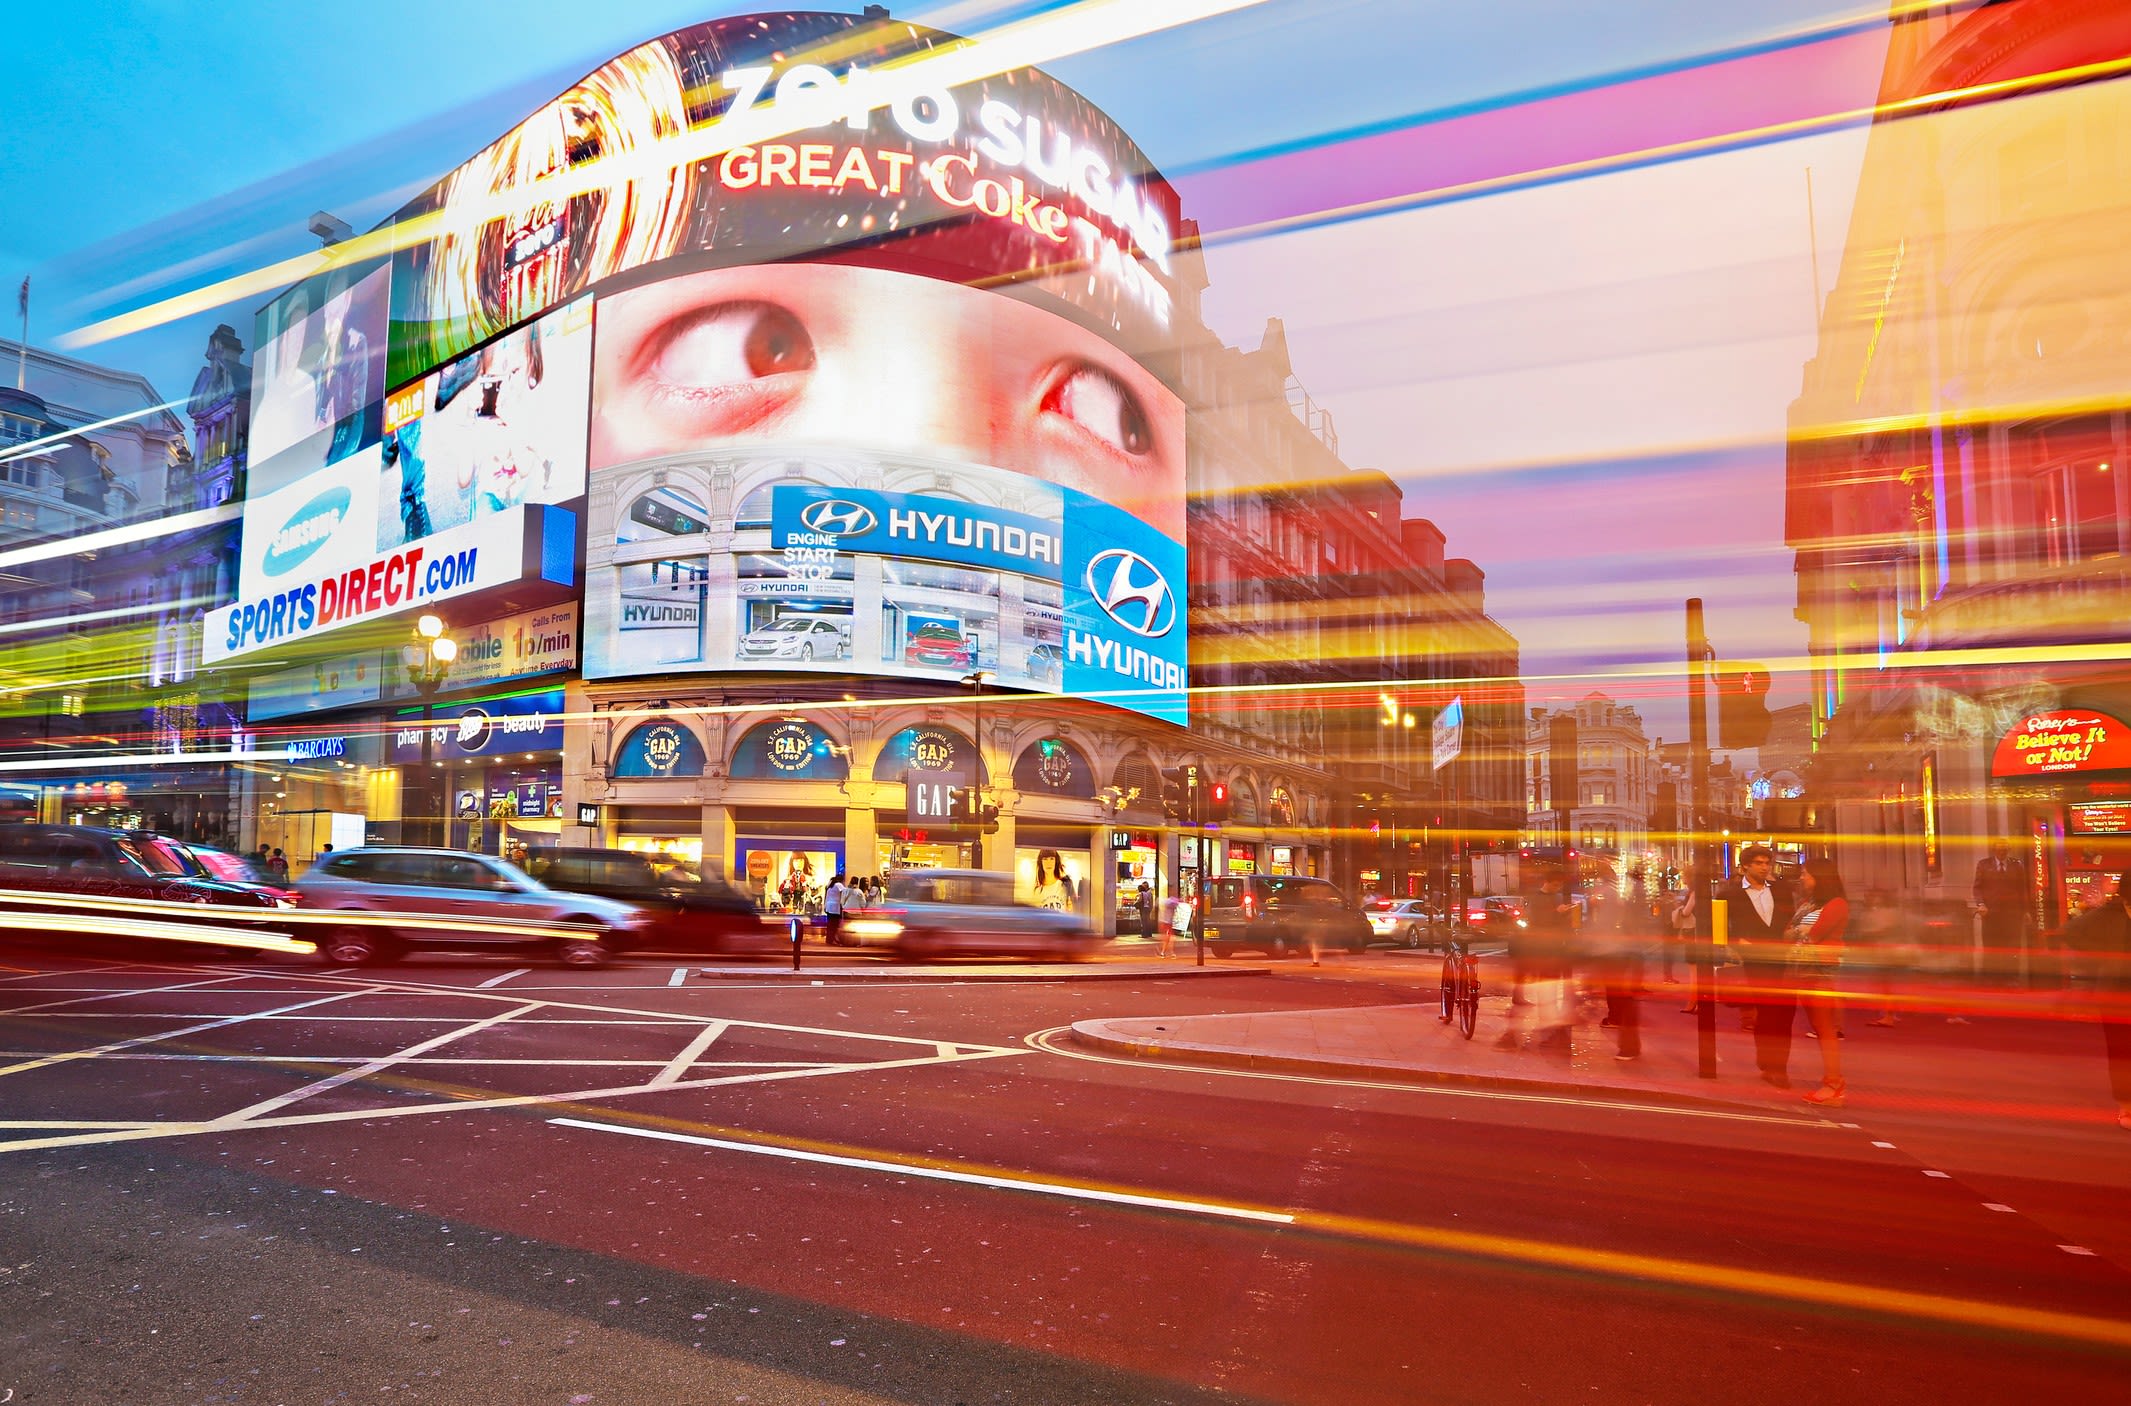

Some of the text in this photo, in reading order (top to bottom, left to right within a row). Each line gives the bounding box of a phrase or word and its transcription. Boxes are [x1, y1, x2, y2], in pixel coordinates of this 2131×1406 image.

[977, 99, 1172, 277] SUGAR
[719, 143, 1172, 327] GREAT Coke TASTE
[271, 508, 340, 558] SAMSUNG
[787, 533, 838, 547] ENGINE
[888, 507, 1062, 566] HYUNDAI
[783, 547, 839, 563] START
[786, 564, 833, 581] STOP
[760, 583, 809, 593] HYUNDAI
[225, 547, 478, 652] SPORTSDIRECT.COM
[532, 612, 571, 628] Calls From
[623, 605, 697, 622] HYUNDAI
[1040, 611, 1078, 626] HYUNDAI
[457, 635, 502, 662] obile
[540, 658, 573, 671] Everyday
[1067, 630, 1186, 696] HYUNDAI
[503, 710, 546, 734] beauty
[298, 737, 344, 759] BARCLAYS
[650, 737, 676, 756] GAP
[774, 736, 807, 756] GAP
[2015, 727, 2106, 750] Believe It
[917, 743, 948, 763] GAP
[2025, 743, 2093, 765] or Not!
[1043, 755, 1068, 773] GAP
[2041, 763, 2077, 771] LONDON
[916, 783, 959, 817] GAP
[580, 807, 597, 823] GAP
[1113, 832, 1128, 847] GAP
[2065, 876, 2081, 884] orld
